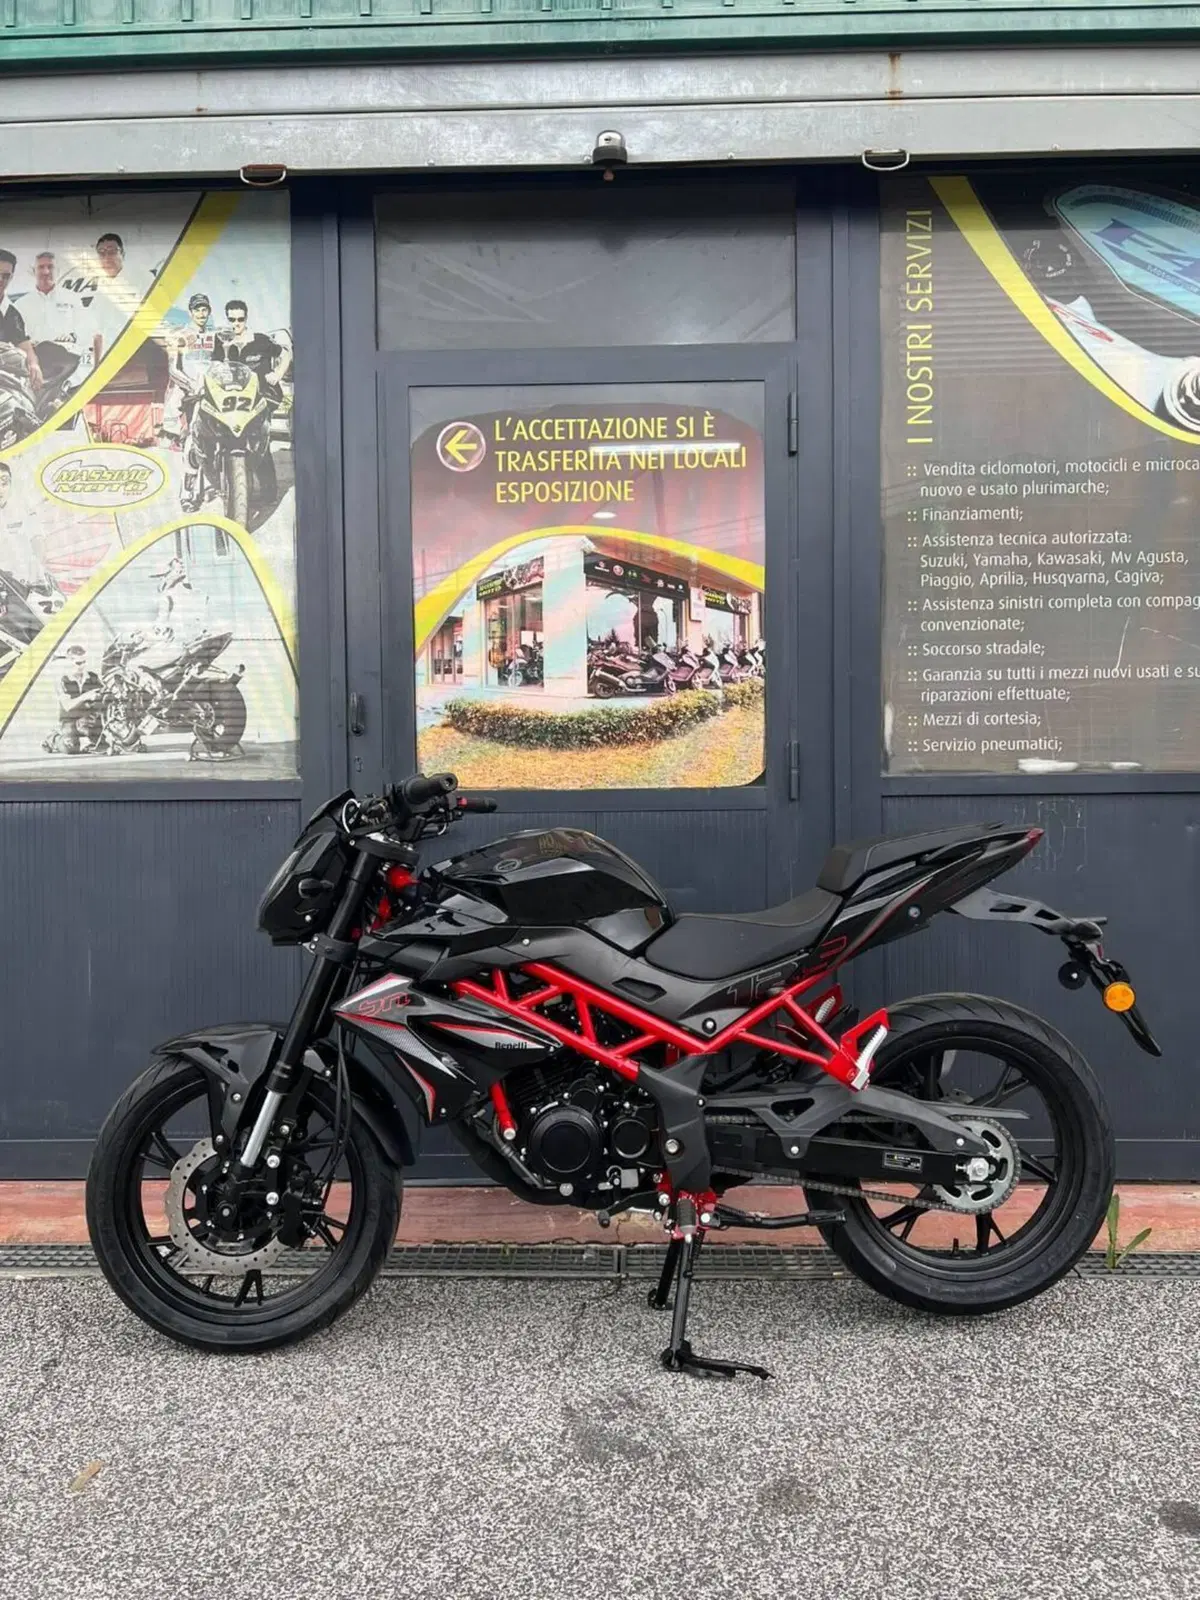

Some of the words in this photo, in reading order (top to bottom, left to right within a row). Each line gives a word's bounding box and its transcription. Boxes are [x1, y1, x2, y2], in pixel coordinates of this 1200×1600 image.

[906, 210, 933, 312] SERVIZI
[906, 324, 933, 424] NOSTRI
[221, 396, 253, 413] 92
[494, 417, 668, 441] L'ACCETTAZIONE
[675, 416, 694, 438] SI
[703, 410, 715, 437] È
[494, 450, 622, 472] TRASFERITA
[629, 449, 664, 470] NEI
[673, 446, 746, 469] LOCALI
[923, 462, 976, 476] Vendita
[980, 460, 1060, 476] ciclomotori,
[1065, 458, 1128, 473] motocicli
[1132, 460, 1141, 472] e
[496, 480, 635, 503] ESPOSIZIONE
[920, 484, 962, 496] nuovo
[967, 483, 976, 496] e
[980, 481, 1018, 495] usato
[1022, 479, 1109, 497] plurimarche;
[922, 507, 1023, 522] Finanziamenti;
[922, 532, 994, 547] Assistenza
[998, 531, 1047, 545] tecnica
[1051, 530, 1132, 544] autorizzata:
[920, 553, 968, 569] Suzuki,
[973, 552, 1032, 567] Yamaha,
[1037, 550, 1105, 566] Kawasaki,
[1111, 551, 1132, 564] Mv
[1137, 549, 1189, 566] Agusta,
[920, 573, 975, 589] Piaggio,
[980, 571, 1028, 587] Aprilia,
[1033, 571, 1109, 586] Husqvarna,
[1115, 569, 1164, 586] Cagiva;
[922, 597, 994, 611] Assistenza
[998, 595, 1044, 609] sinistri
[1048, 594, 1113, 611] completa
[1117, 596, 1141, 608] con
[920, 616, 1025, 632] convenzionate;
[922, 642, 981, 656] Soccorso
[986, 640, 1045, 656] stradale;
[922, 667, 982, 681] Garanzia
[987, 668, 1001, 680] su
[1006, 666, 1036, 680] tutti
[1049, 665, 1089, 679] mezzi
[1094, 664, 1132, 679] nuovi
[1136, 664, 1170, 679] usati
[1174, 665, 1183, 677] e
[921, 687, 993, 705] riparazioni
[998, 686, 1071, 702] effettuate;
[923, 712, 962, 726] Mezzi
[967, 712, 979, 726] di
[984, 711, 1041, 727] cortesia;
[922, 738, 976, 751] Servizio
[981, 736, 1063, 753] pneumatici;
[494, 1041, 528, 1050] Benelli
